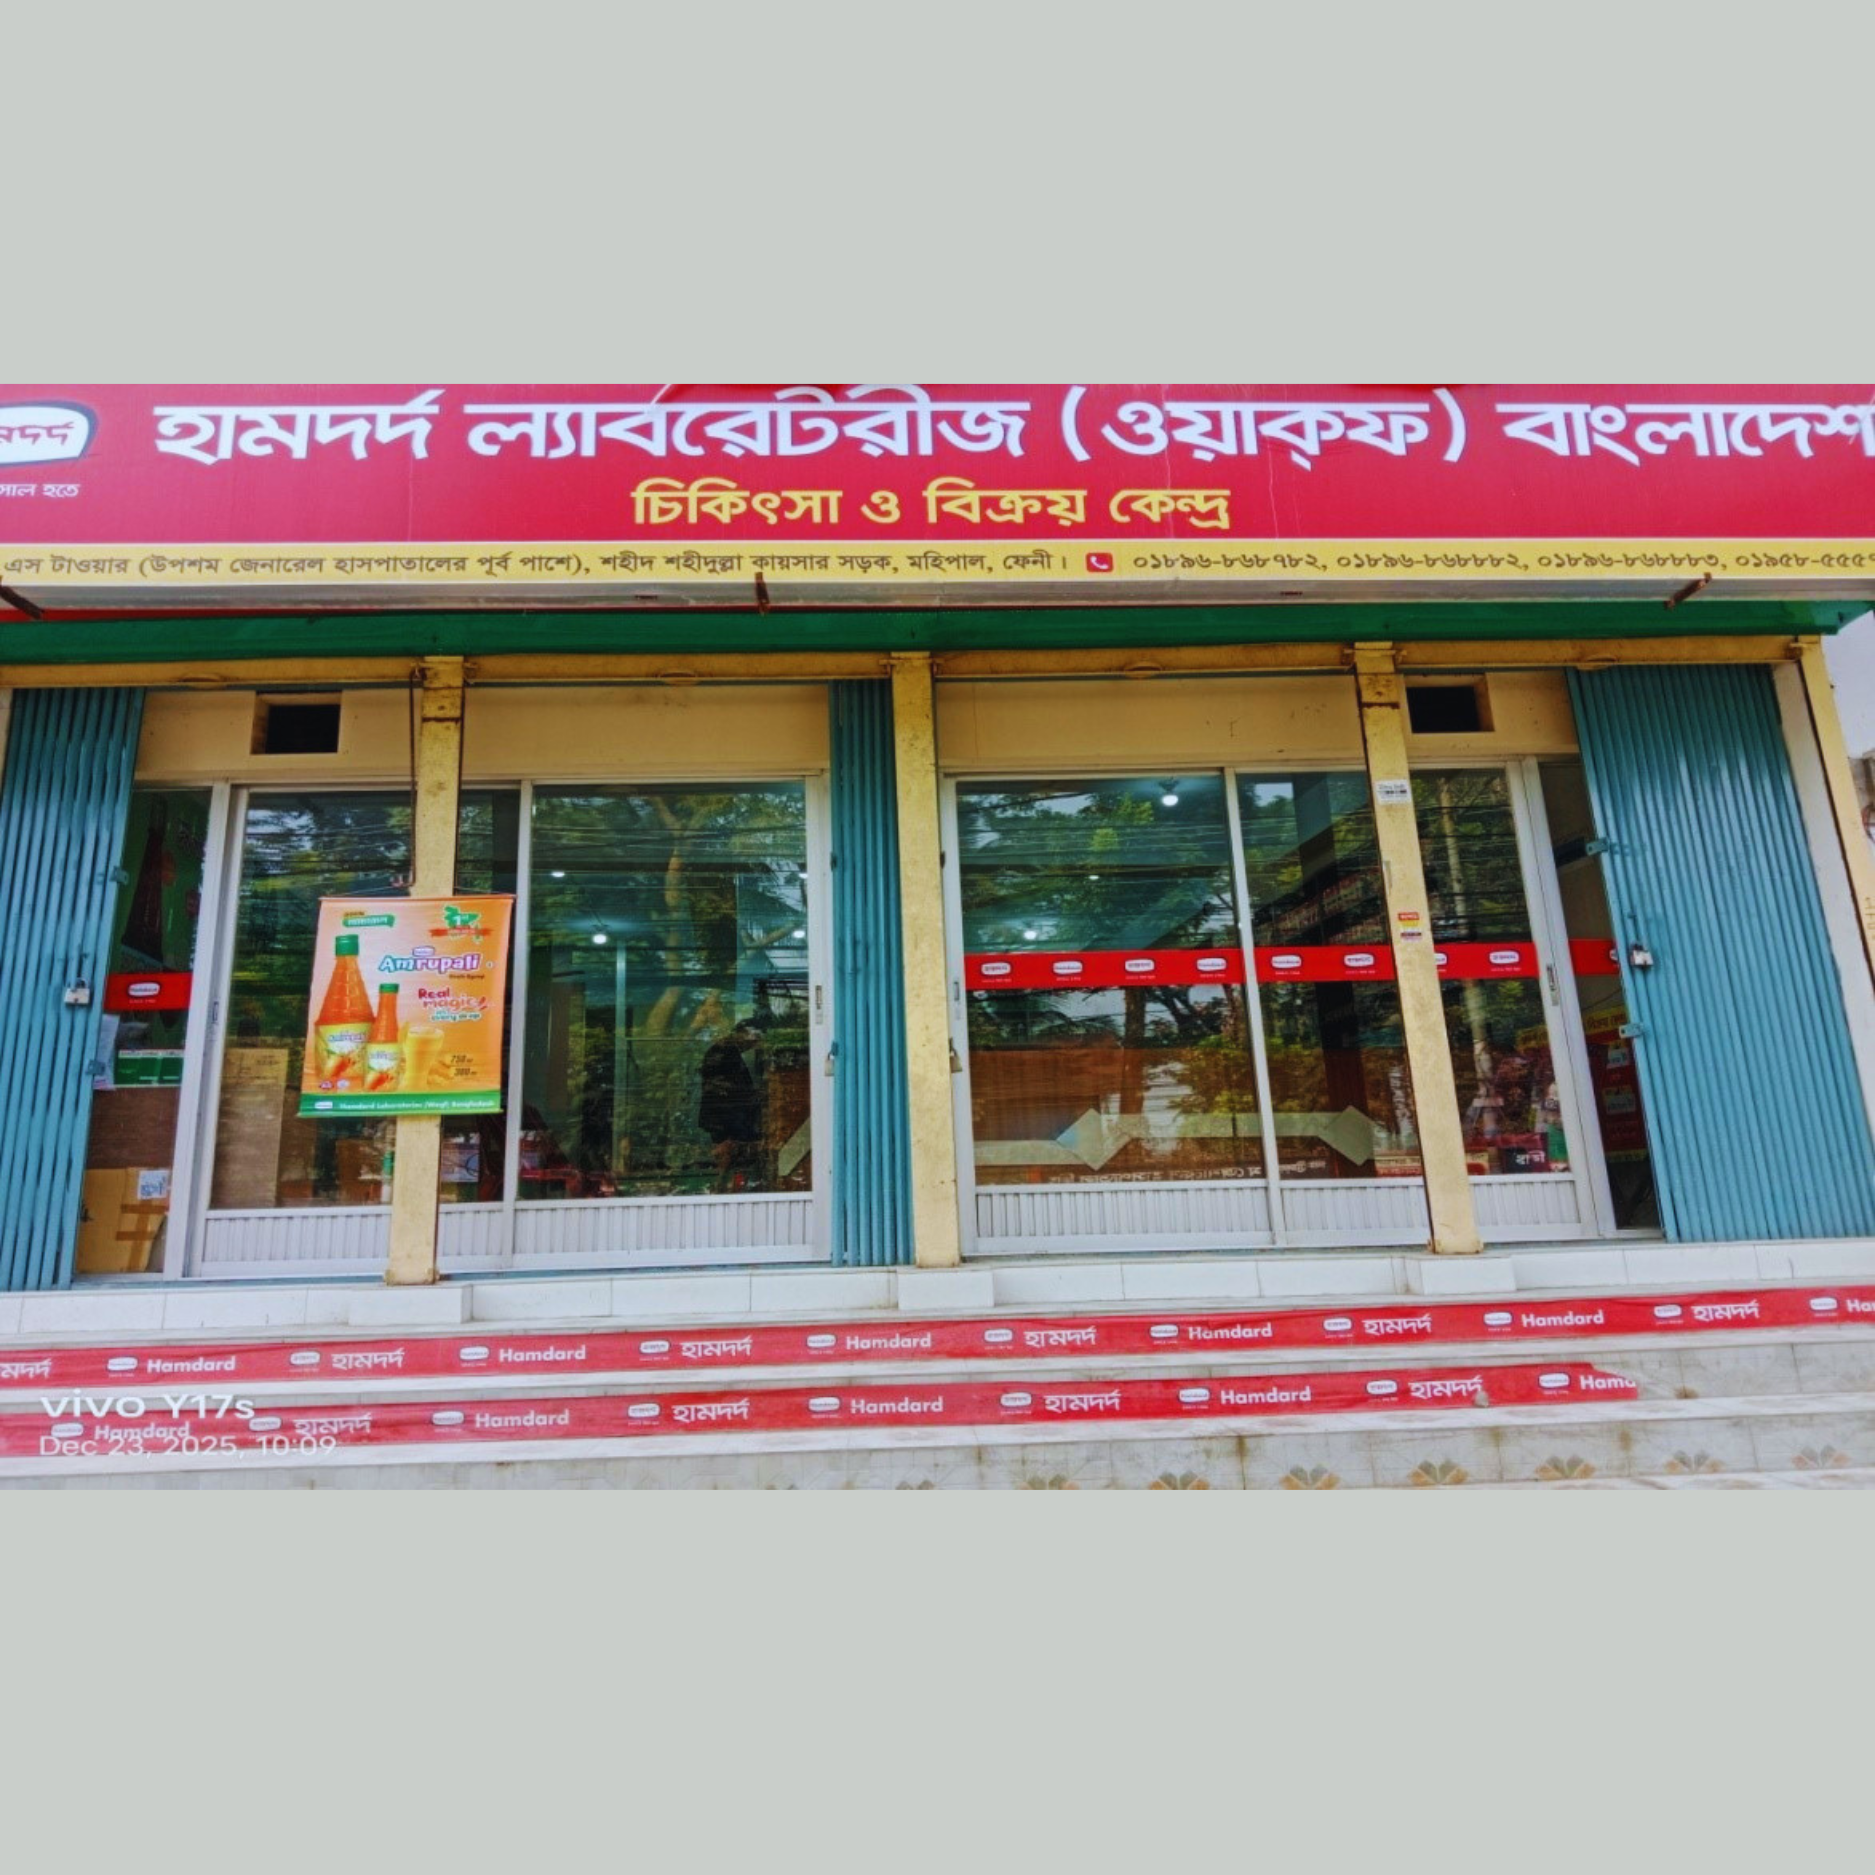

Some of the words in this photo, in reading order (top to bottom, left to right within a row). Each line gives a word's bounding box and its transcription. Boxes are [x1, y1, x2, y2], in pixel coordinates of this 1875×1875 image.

[153, 388, 446, 465] হামদর্দ
[463, 384, 1031, 459] ল্যাবরেটরীজ
[1496, 402, 1875, 466] বাংলাদেশ
[42, 484, 81, 498] হতে
[630, 476, 843, 525] চিকিৎসা
[861, 489, 900, 524] ও
[923, 476, 1088, 527] বিক্রয়
[1109, 488, 1231, 530] কেন্দ্র
[4, 557, 44, 574] এস
[50, 553, 130, 575] টাওয়ার
[138, 553, 222, 578] (উপশম
[229, 555, 324, 574] জেনারেল
[333, 554, 469, 574] হাসপাতালের
[477, 551, 514, 577] পূর্ব
[519, 553, 591, 576] পাশে),
[599, 549, 657, 572] শহীদ
[664, 549, 744, 575] শহীদুল্লা
[749, 554, 830, 572] কায়সার
[838, 554, 899, 574] সড়ক,
[906, 550, 994, 574] মহিপাল,
[1133, 552, 1329, 572] ০১৮৯৬-৮৬৮৭৮২,
[1337, 552, 1530, 572] ০১৮৯৬-৮৬৮৮৮২,
[378, 953, 482, 975] Amrupali
[418, 988, 450, 999] Real
[147, 1355, 236, 1373] Hamdard
[331, 1347, 405, 1370] হামদর্দ
[499, 1344, 586, 1363] Hamdard
[680, 1336, 753, 1359] হামদর্দ
[846, 1333, 932, 1350] Hamdard
[1023, 1326, 1097, 1348] হামদর্দ
[1188, 1323, 1273, 1341] Hamdard
[1362, 1314, 1432, 1336] হামদর্দ
[1521, 1310, 1605, 1328] Hamdard
[1691, 1299, 1760, 1322] হামদর্দ
[1846, 1299, 1875, 1312] Ha
[94, 1421, 190, 1441] Hamdard
[293, 1412, 374, 1437] হামদর্দ
[475, 1410, 570, 1429] Hamdard
[672, 1399, 750, 1423] হামদর্দ
[850, 1396, 944, 1414] Hamdard
[1043, 1389, 1123, 1413] হামদর্দ
[1220, 1386, 1312, 1405] Hamdard
[1408, 1375, 1484, 1399] হামদর্দ
